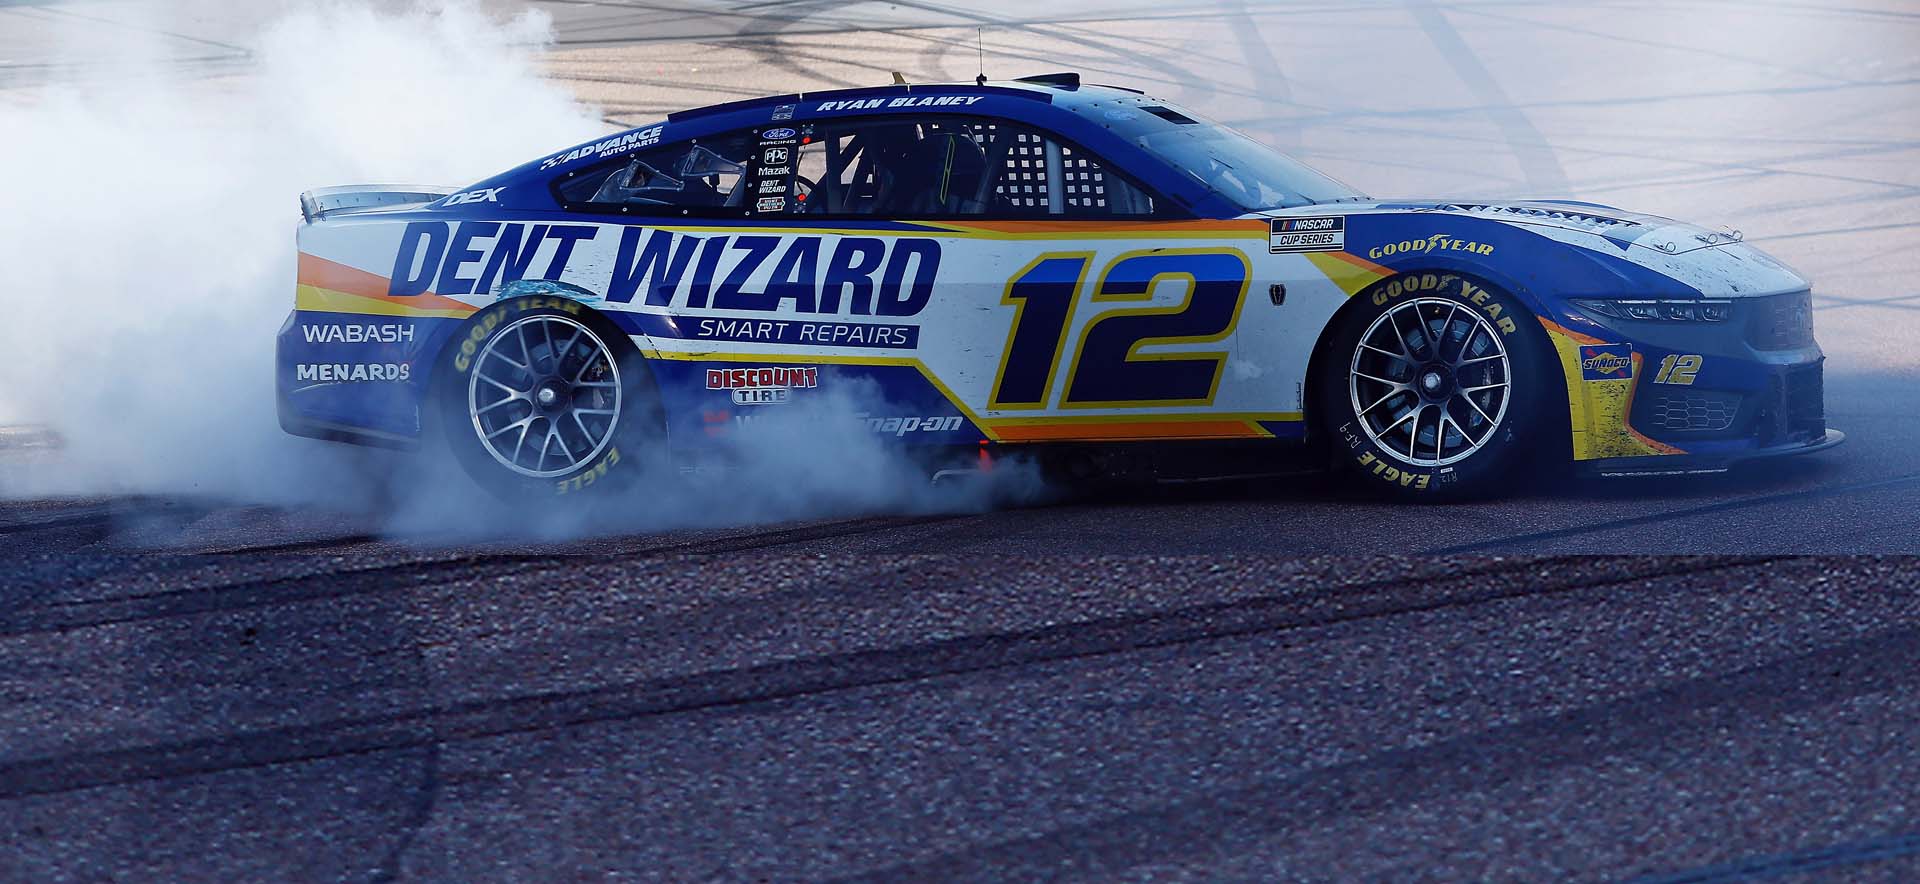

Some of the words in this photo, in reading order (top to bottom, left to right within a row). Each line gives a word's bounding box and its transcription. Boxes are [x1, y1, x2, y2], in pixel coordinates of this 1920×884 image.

[816, 99, 886, 112] RYAN
[887, 96, 984, 108] BLANEY
[560, 126, 663, 164] ADVANCE
[599, 145, 627, 158] AUTO
[628, 136, 660, 151] PARTS
[758, 165, 791, 176] Mazak
[758, 186, 787, 194] WIZARD
[1293, 218, 1335, 231] NASCAR
[1280, 235, 1300, 246] CUP
[1301, 233, 1335, 245] SERIES
[388, 221, 600, 298] DENT
[604, 226, 943, 318] WIZARD
[302, 324, 415, 343] WABASH
[697, 319, 790, 341] SMART
[799, 324, 910, 346] REPAIRS
[986, 247, 1253, 411] 12
[296, 363, 411, 381] MENARDS
[1583, 357, 1631, 371] SUNOCO
[1652, 354, 1704, 386] 12
[706, 367, 818, 390] DISCOUNT
[738, 389, 787, 403] TIRE
[1357, 450, 1431, 489] EAGLE
